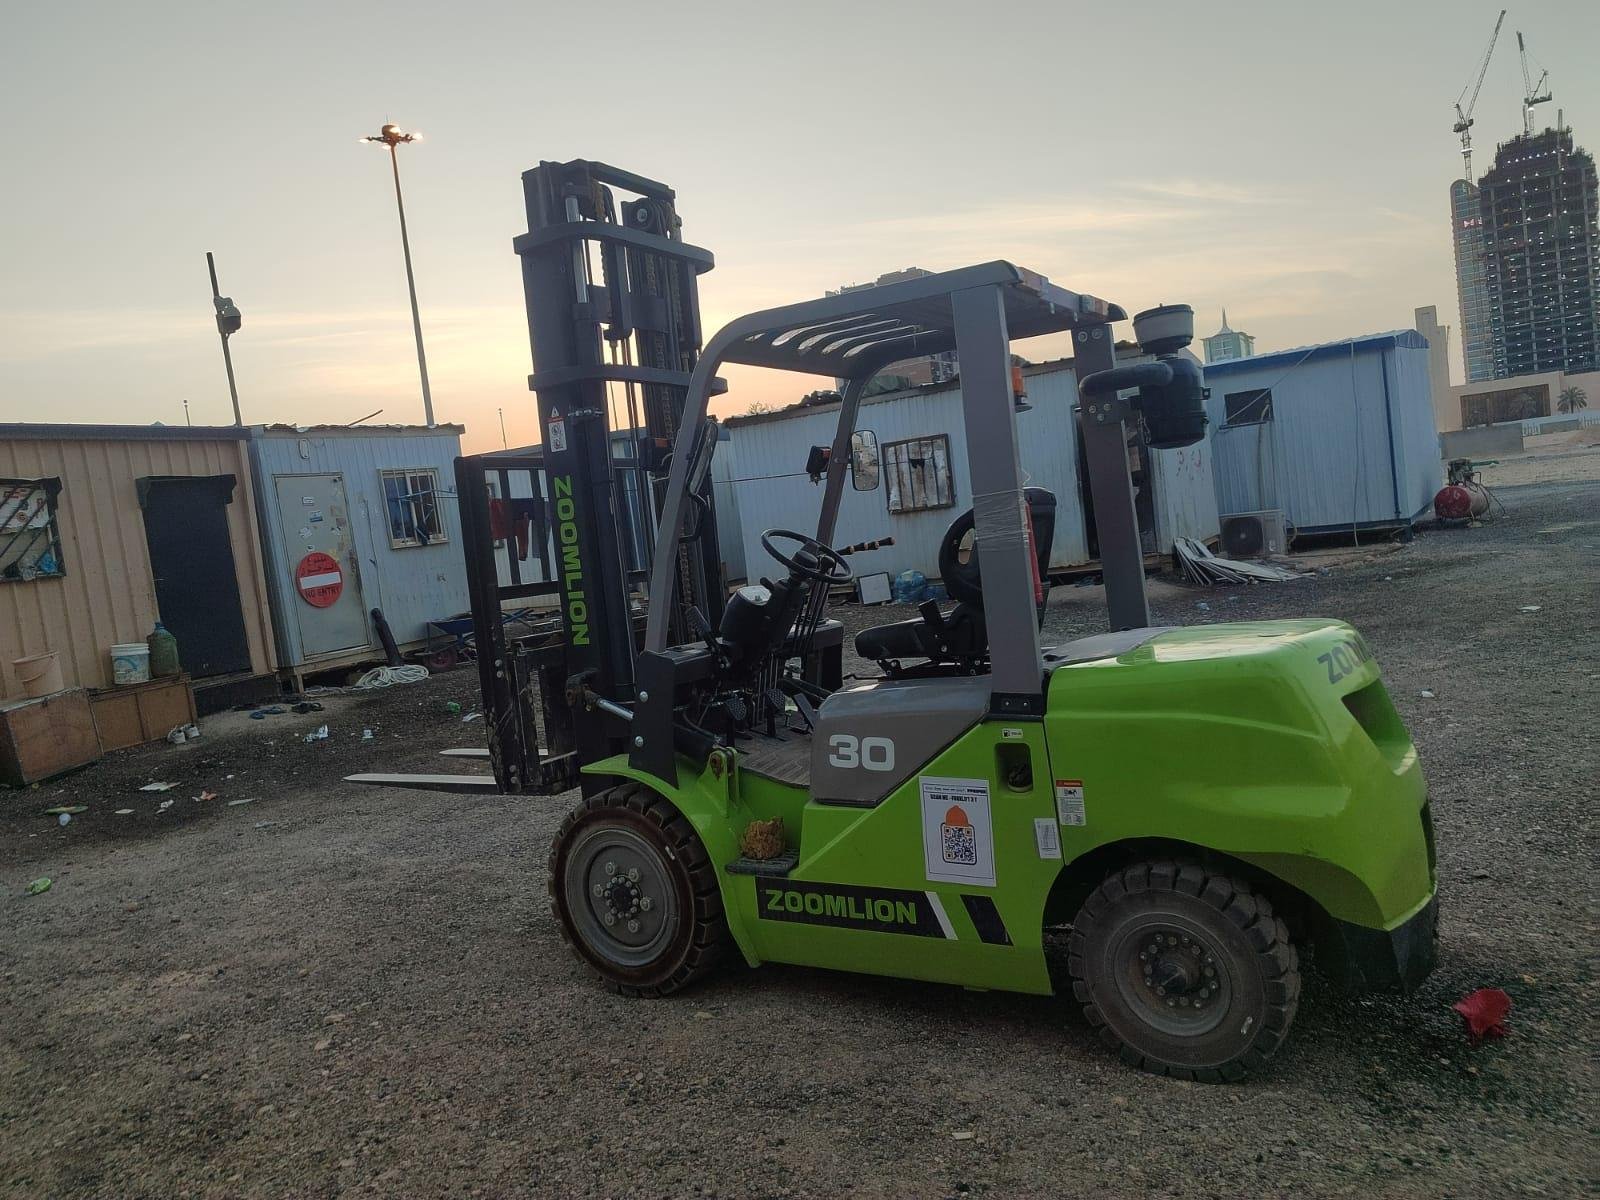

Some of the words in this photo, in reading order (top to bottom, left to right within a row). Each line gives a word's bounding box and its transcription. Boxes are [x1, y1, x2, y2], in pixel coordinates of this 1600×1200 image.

[553, 474, 590, 646] ZOOMLION
[305, 588, 316, 599] NO
[318, 586, 340, 597] ENTRY
[829, 734, 895, 772] 30
[765, 889, 917, 925] ZOOMLION
